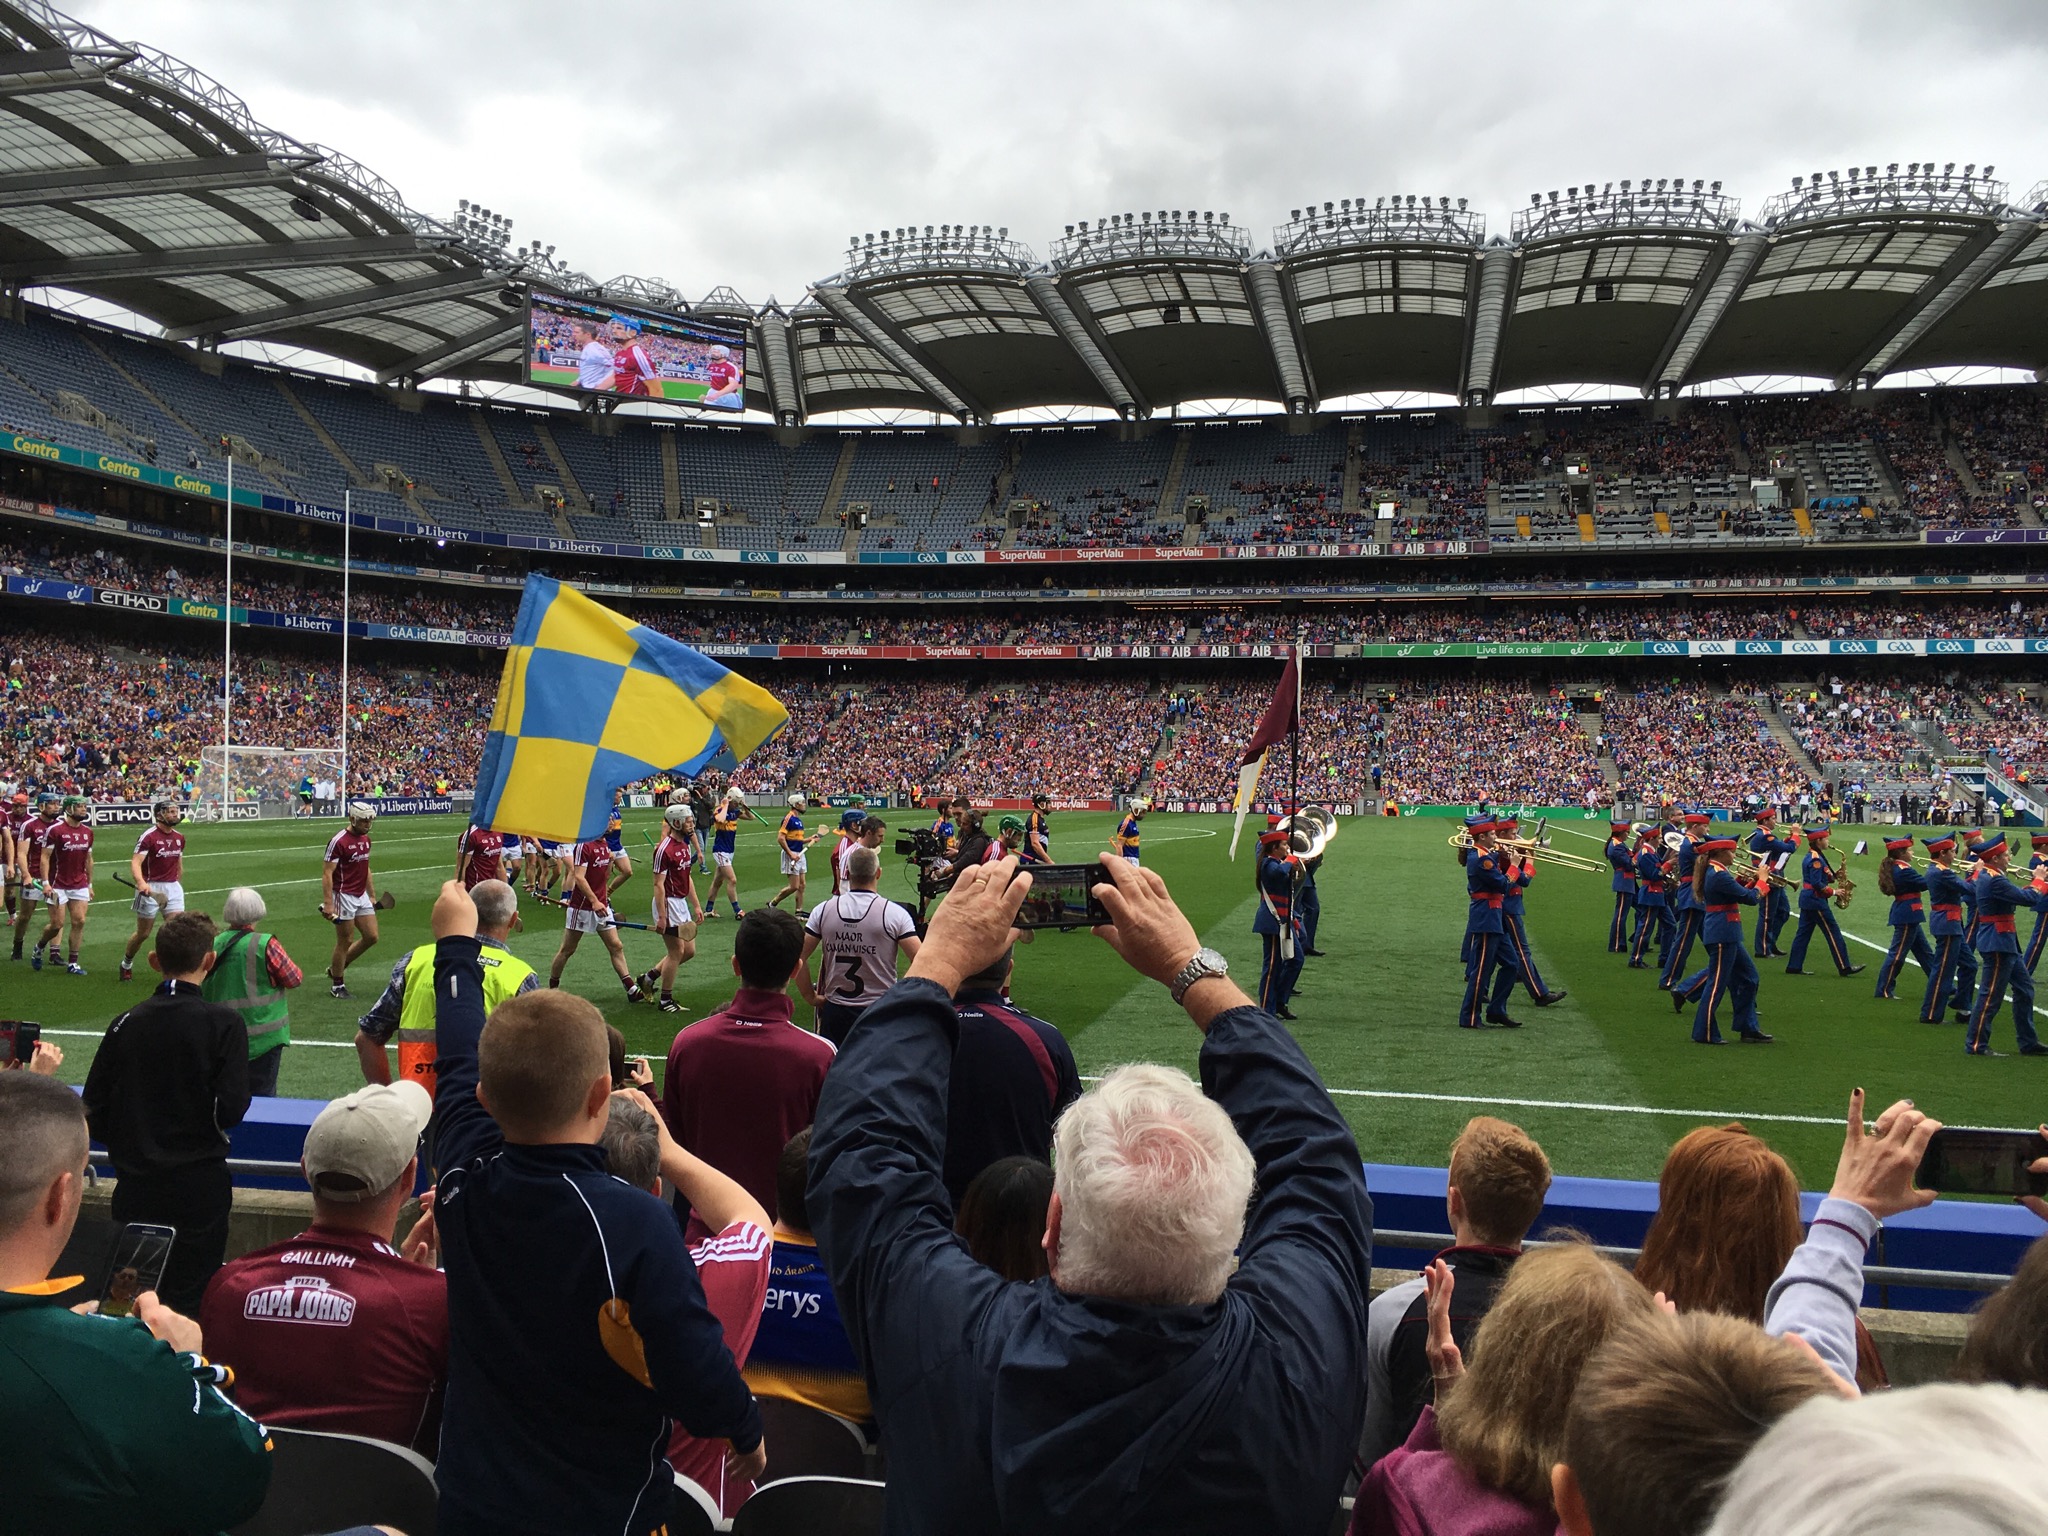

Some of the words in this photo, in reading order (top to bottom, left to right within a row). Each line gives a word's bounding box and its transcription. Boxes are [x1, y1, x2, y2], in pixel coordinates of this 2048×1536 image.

[552, 357, 579, 366] ETI
[13, 436, 60, 459] Centra
[99, 456, 140, 478] Centra
[174, 475, 211, 495] Centra
[5, 498, 34, 511] IRELAND
[38, 503, 55, 516] bob
[302, 503, 342, 523] Liberty
[137, 524, 163, 537] Liberty
[425, 525, 469, 542] Liberty
[1985, 530, 2005, 543] eir
[178, 532, 202, 544] Liberty
[1945, 531, 1966, 543] eir
[558, 540, 603, 554] Liberty
[652, 547, 676, 558] GAA
[1238, 546, 1258, 558] AIB
[1277, 545, 1297, 557] AIB
[1320, 545, 1340, 557] AIB
[1360, 544, 1380, 556] AIB
[1405, 543, 1426, 555] AIB
[1446, 542, 1468, 554] AIB
[692, 549, 714, 560] GAA
[748, 552, 771, 562] GAA
[786, 553, 808, 563] GAA
[917, 553, 940, 563] GAA
[955, 553, 976, 563] GAA
[999, 550, 1046, 562] SuperValu
[1076, 549, 1124, 561] SuperValu
[1155, 547, 1204, 560] SuperValu
[24, 579, 42, 594] eir
[1487, 583, 1519, 591] netwatch
[1703, 579, 1717, 588] AIB
[1728, 579, 1743, 587] AIB
[1757, 578, 1771, 587] AIB
[1783, 577, 1797, 586] AIB
[66, 585, 84, 600] eir
[649, 587, 682, 595] AUTOBODY
[841, 591, 864, 599] GAA.ie
[1209, 587, 1234, 595] group
[1255, 586, 1280, 595] group
[1349, 585, 1376, 593] Kingspan
[100, 590, 162, 610] ETIHAD
[181, 601, 218, 618] Centra
[291, 615, 332, 632] Liberty
[390, 626, 427, 641] GAA.ie
[429, 629, 464, 643] GAA.ie
[466, 632, 497, 646] CROKE
[499, 634, 511, 647] PA
[699, 645, 749, 655] MUSEUM
[821, 646, 867, 657] SuperValu
[925, 646, 971, 658] SuperValu
[1015, 646, 1062, 658] SuperValu
[1093, 646, 1113, 658] AIB
[1131, 646, 1151, 658] AIB
[1171, 646, 1191, 657] AIB
[1210, 645, 1230, 657] AIB
[1251, 645, 1271, 657] AIB
[1397, 644, 1415, 657] eir
[1433, 644, 1451, 656] eir
[1476, 645, 1494, 654] Live
[1498, 645, 1517, 654] life
[1530, 646, 1543, 654] eir
[1570, 643, 1589, 655] eir
[1608, 643, 1627, 655] eir
[1653, 642, 1680, 654] GAA
[1698, 642, 1725, 653] GAA
[1745, 642, 1773, 653] GAA
[1791, 642, 1819, 653] GAA
[1839, 641, 1868, 652] GAA
[1887, 641, 1915, 652] GAA
[1936, 641, 1964, 652] GAA
[1985, 640, 2013, 652] GAA
[386, 800, 418, 816] Liberty
[424, 799, 452, 815] Liberty
[970, 799, 994, 807] erValu
[1051, 799, 1090, 811] uperValu
[1166, 802, 1185, 813] AIB
[1199, 802, 1217, 813] AIB
[1624, 803, 1634, 811] 30
[96, 804, 151, 822] ETIHAD
[1334, 804, 1353, 816] AIB
[1404, 806, 1421, 817] eir
[1466, 807, 1482, 818] Liv
[1490, 807, 1505, 818] life
[1523, 809, 1537, 818] eir
[835, 931, 863, 942] MAOR
[852, 944, 877, 955] UISCE
[835, 955, 865, 999] 3
[280, 1251, 357, 1268] GAILLIMH
[295, 1278, 321, 1286] PIZZA
[248, 1289, 295, 1318] PAPA
[765, 1287, 821, 1318] erys
